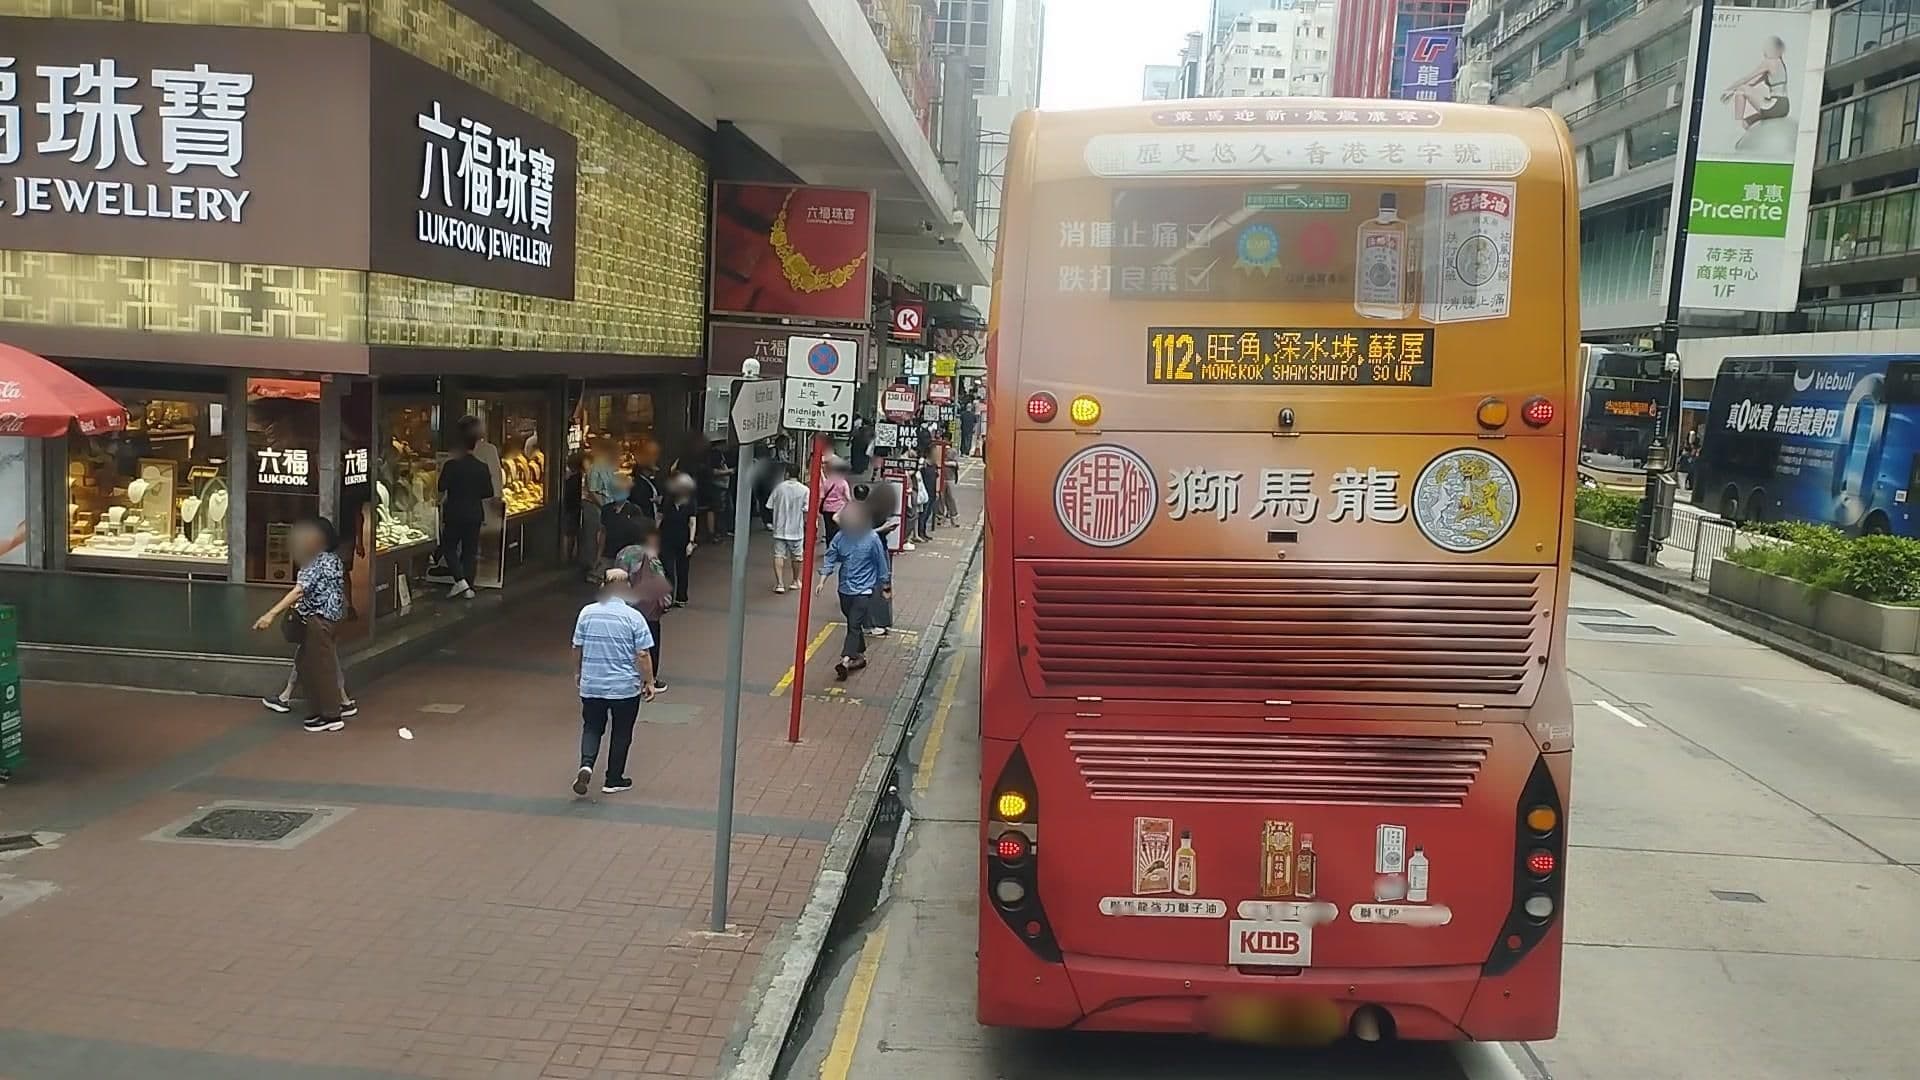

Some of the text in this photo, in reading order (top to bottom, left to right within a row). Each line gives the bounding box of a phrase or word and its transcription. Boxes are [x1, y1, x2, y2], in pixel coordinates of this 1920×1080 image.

[0, 57, 253, 178] 珠寶
[418, 100, 555, 234] 六福珠寶
[12, 177, 249, 222] JEWELLERY
[1742, 182, 1784, 203] 實惠
[1690, 198, 1783, 220] Pricerite
[418, 210, 553, 268] LUKFOOK JEWELLERY
[1060, 220, 1178, 249] 消腫止痛
[1706, 248, 1754, 263] 荷李活
[1697, 265, 1759, 281] 商業中心
[1713, 284, 1736, 298] 1/F
[754, 338, 786, 357] 六福
[1153, 334, 1194, 380] 112
[1815, 371, 1855, 391] Webull
[798, 389, 819, 400] 上午
[831, 385, 842, 402] 7
[788, 407, 849, 430] midnight 12
[900, 426, 918, 437] MK
[258, 447, 309, 476] 六福
[345, 448, 368, 476] 六福
[259, 475, 308, 486] LUKFOOK
[1167, 465, 1409, 523] 獅馬龍
[1240, 931, 1300, 955] KMB
